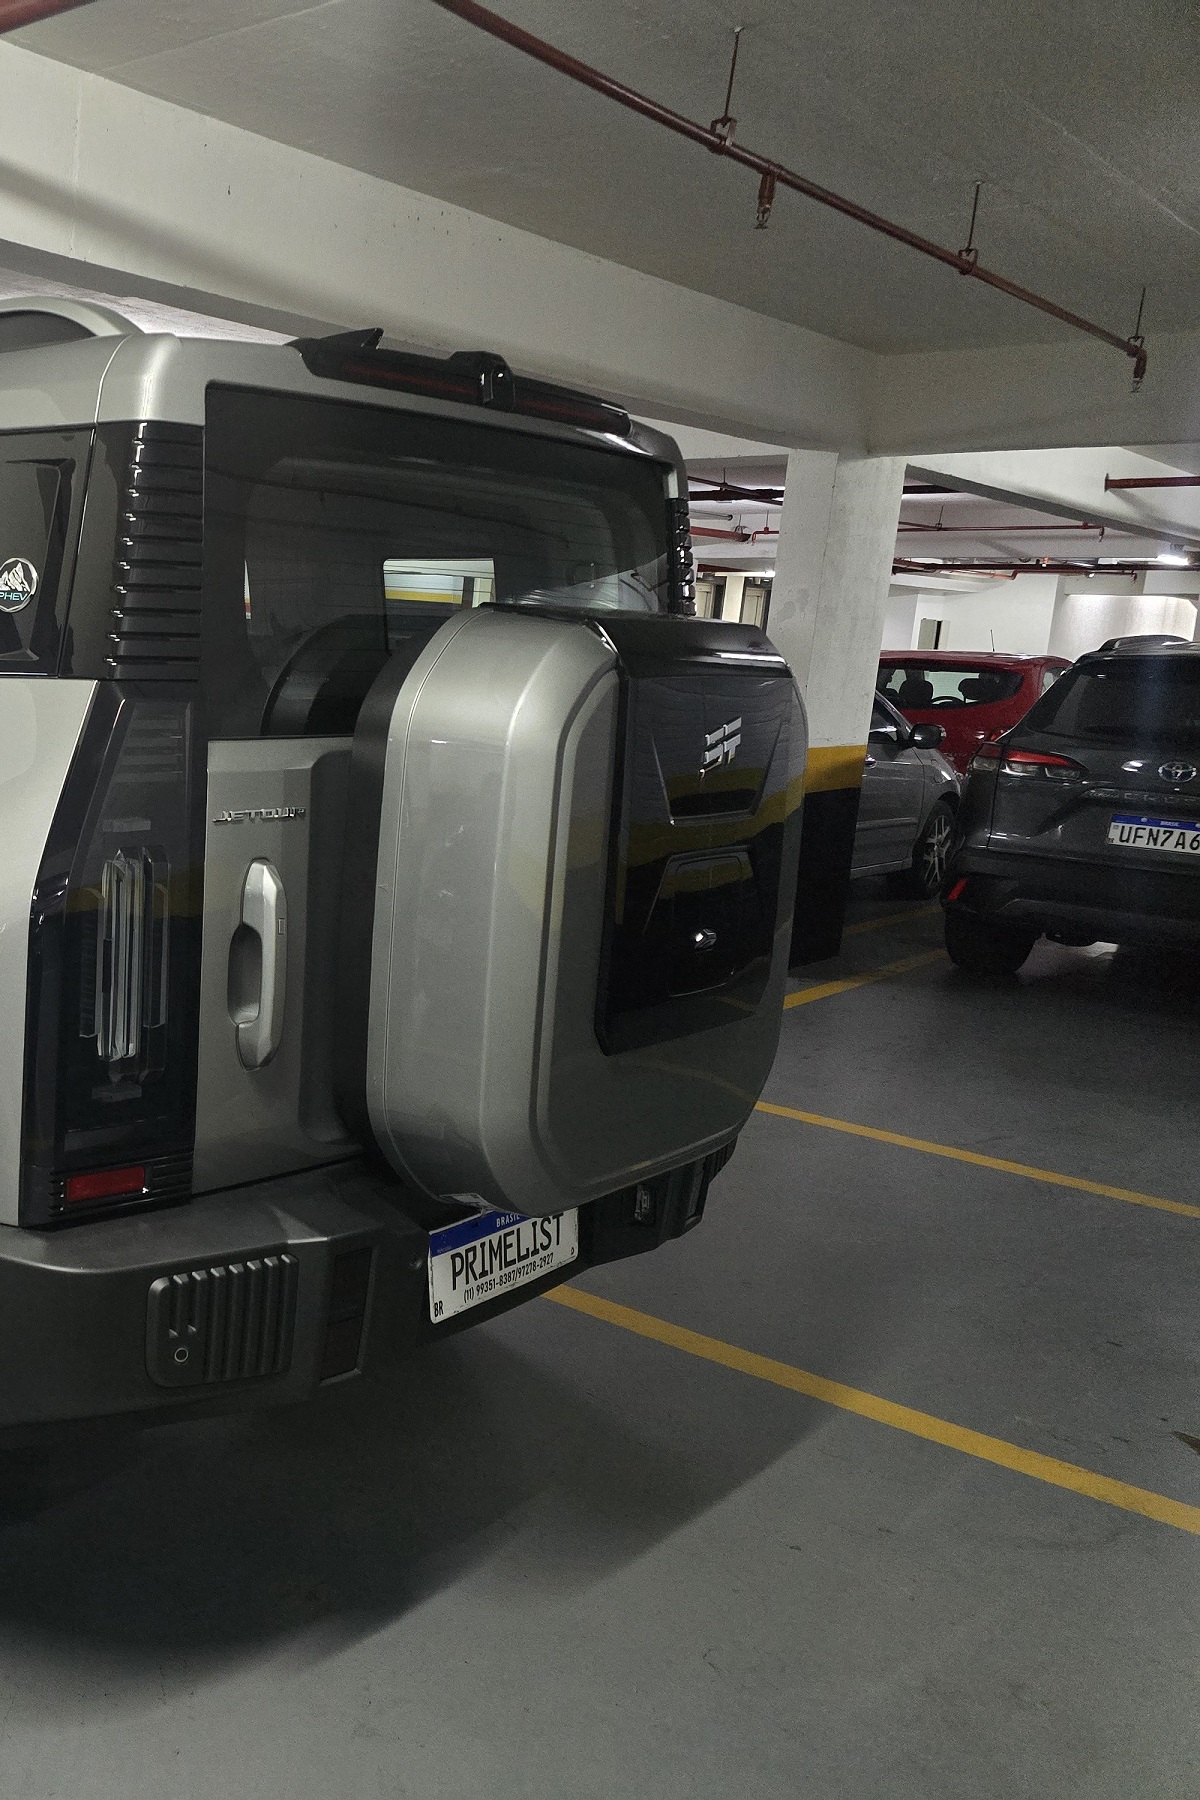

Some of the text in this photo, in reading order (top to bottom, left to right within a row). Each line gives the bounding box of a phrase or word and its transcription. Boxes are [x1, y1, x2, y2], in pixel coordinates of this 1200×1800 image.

[1119, 825, 1200, 850] UFN7A6
[450, 1213, 564, 1291] PRIMELIST
[463, 1286, 475, 1303] (11)
[434, 1300, 444, 1317] BR
